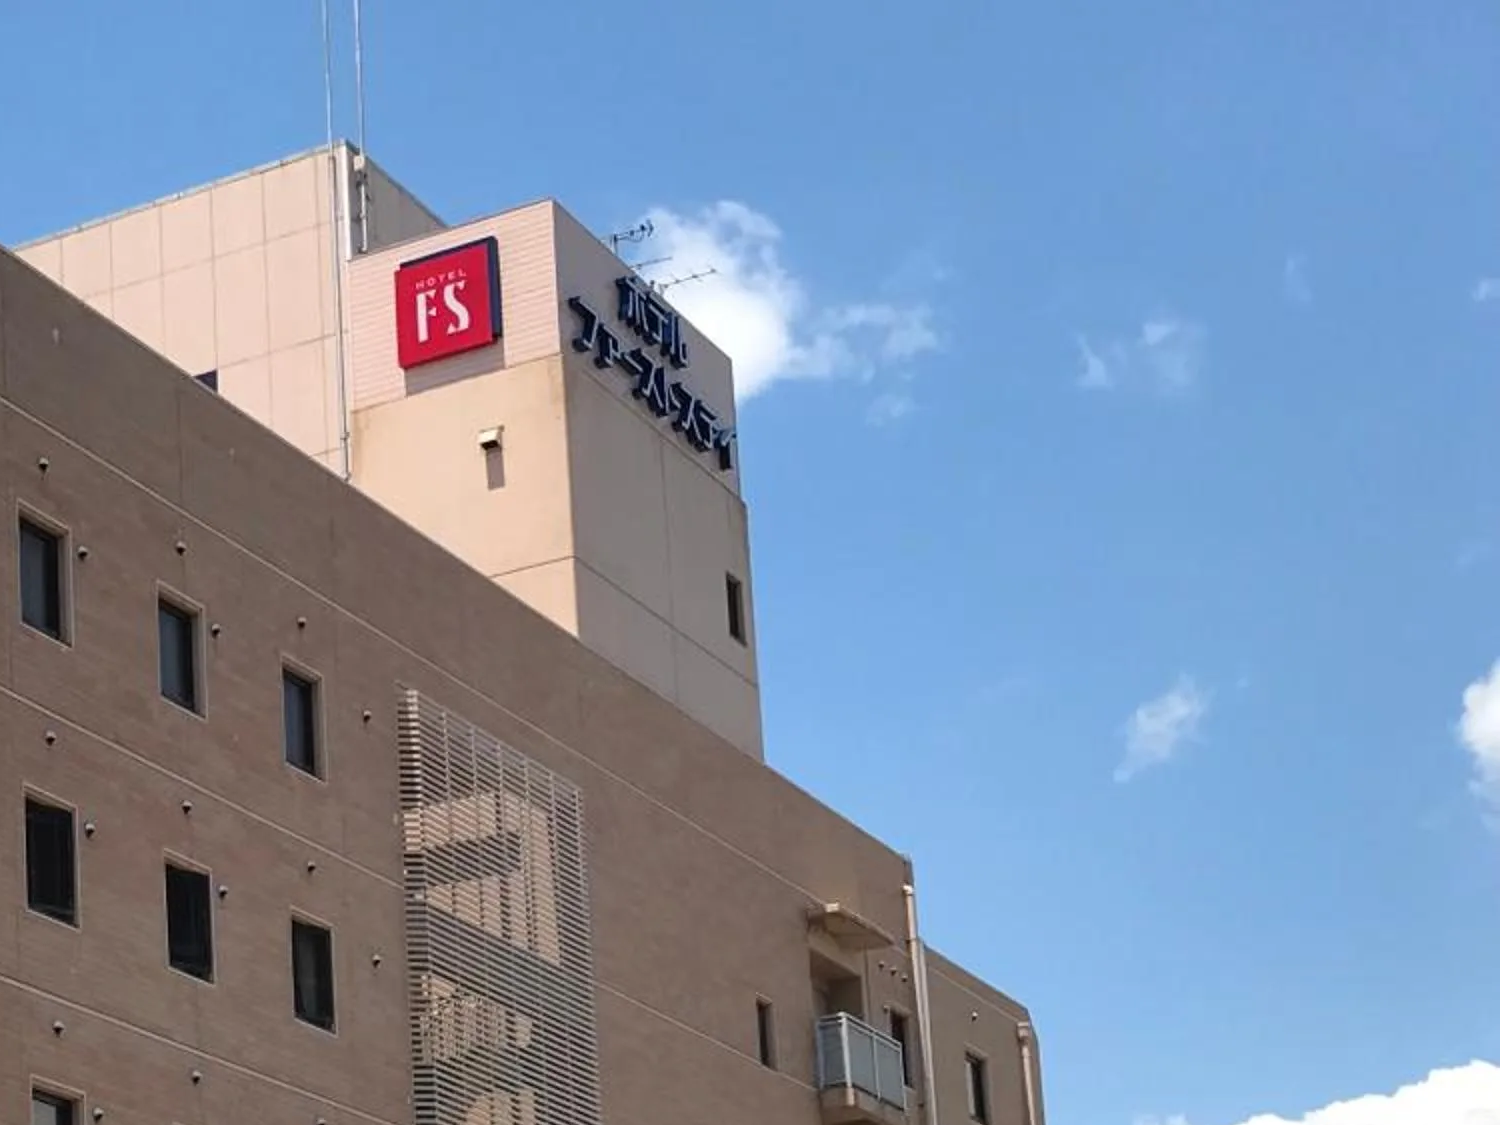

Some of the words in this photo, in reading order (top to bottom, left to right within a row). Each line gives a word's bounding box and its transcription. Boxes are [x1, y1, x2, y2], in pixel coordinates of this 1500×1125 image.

[415, 268, 467, 290] HOTEL
[416, 280, 470, 344] FS
[615, 275, 688, 370] ホテル
[568, 296, 737, 471] ファーストステイ
